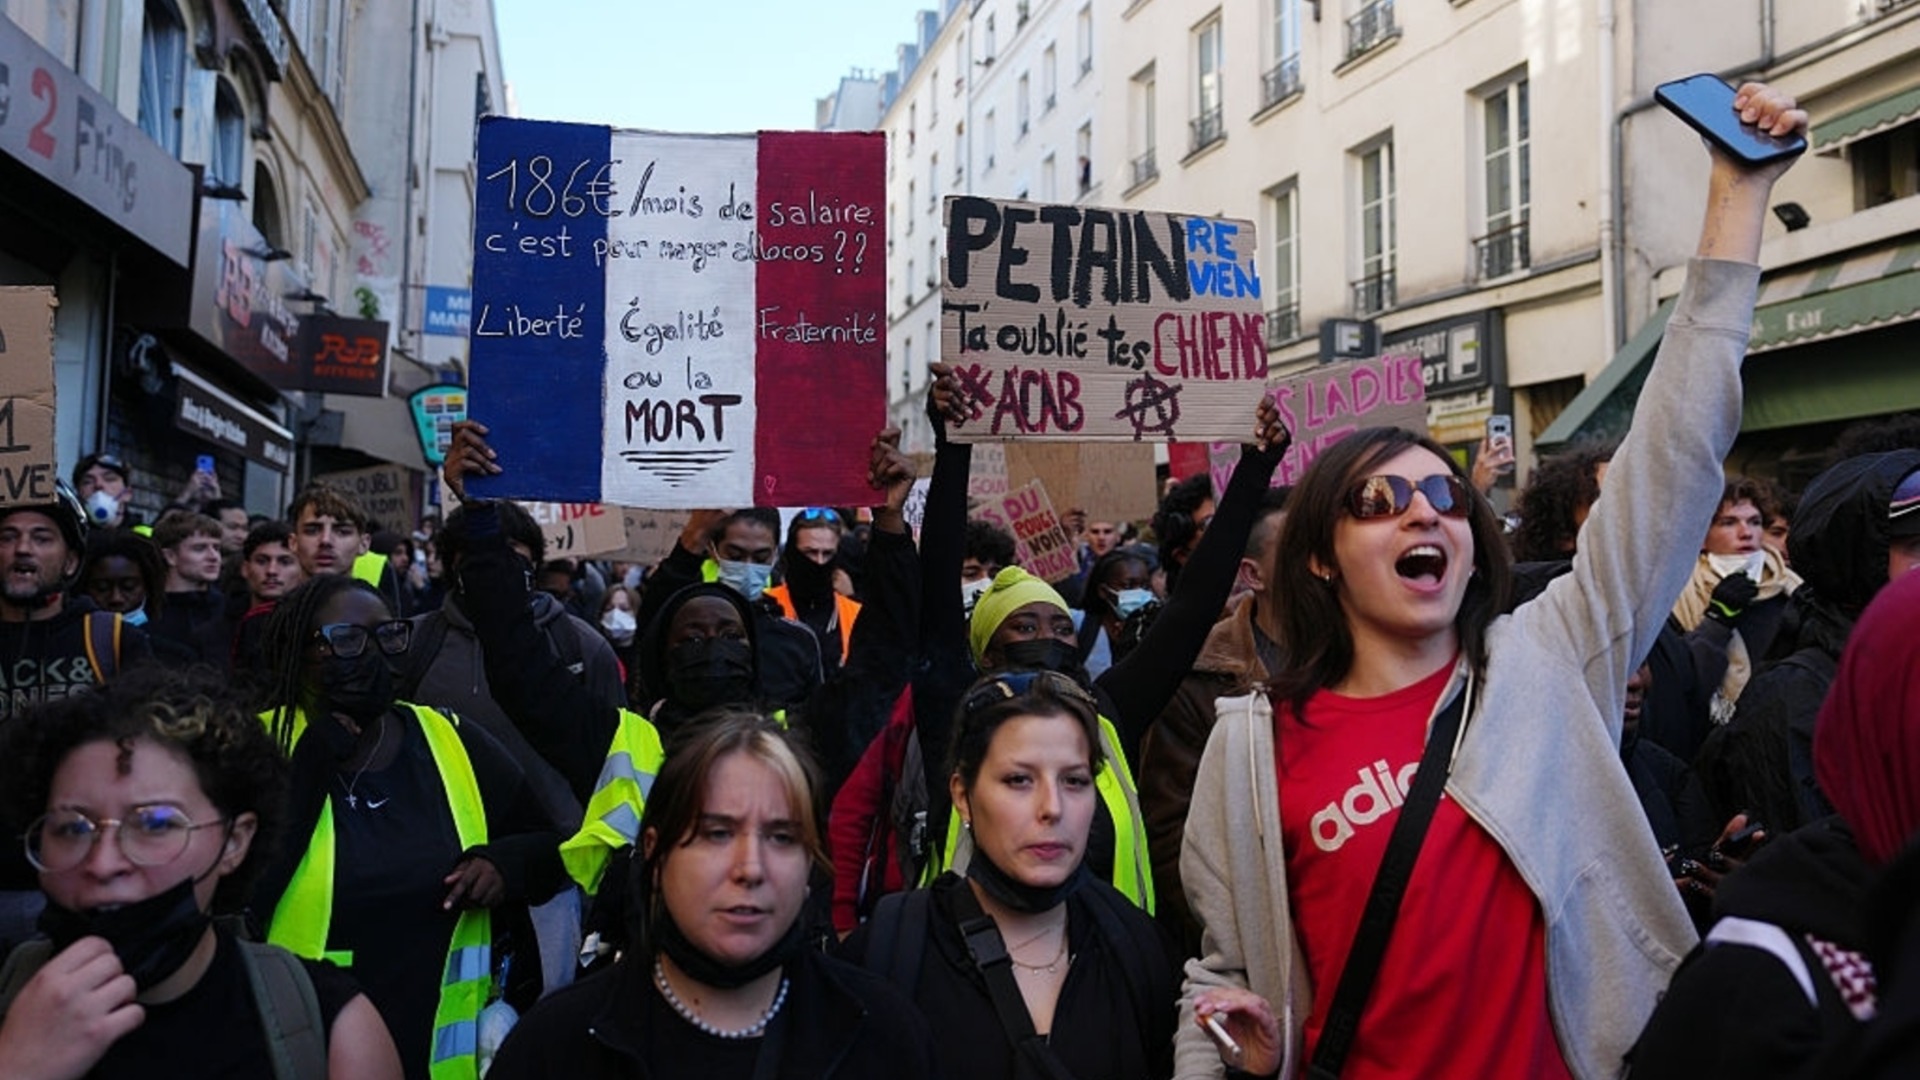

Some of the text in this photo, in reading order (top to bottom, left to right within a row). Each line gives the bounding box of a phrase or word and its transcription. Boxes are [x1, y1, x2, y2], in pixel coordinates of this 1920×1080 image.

[27, 67, 58, 160] 2
[487, 155, 703, 218] 186€/mois
[718, 182, 754, 222] de
[485, 222, 573, 258] c'est
[592, 238, 649, 267] pour
[732, 230, 824, 263] allocos
[833, 230, 868, 274] ??
[947, 196, 1191, 309] PETAIN
[1186, 217, 1239, 259] RE
[1188, 258, 1261, 300] VIEN
[476, 297, 878, 355] Liberté Égalité Fraternité
[996, 307, 1089, 359] oublié
[1097, 314, 1151, 370] tes
[1153, 311, 1269, 381] CHIENS
[623, 356, 713, 390] ou la
[624, 394, 742, 444] MORT
[991, 367, 1085, 436] ACAB
[0, 464, 50, 500] VE
[0, 656, 93, 688] CK&
